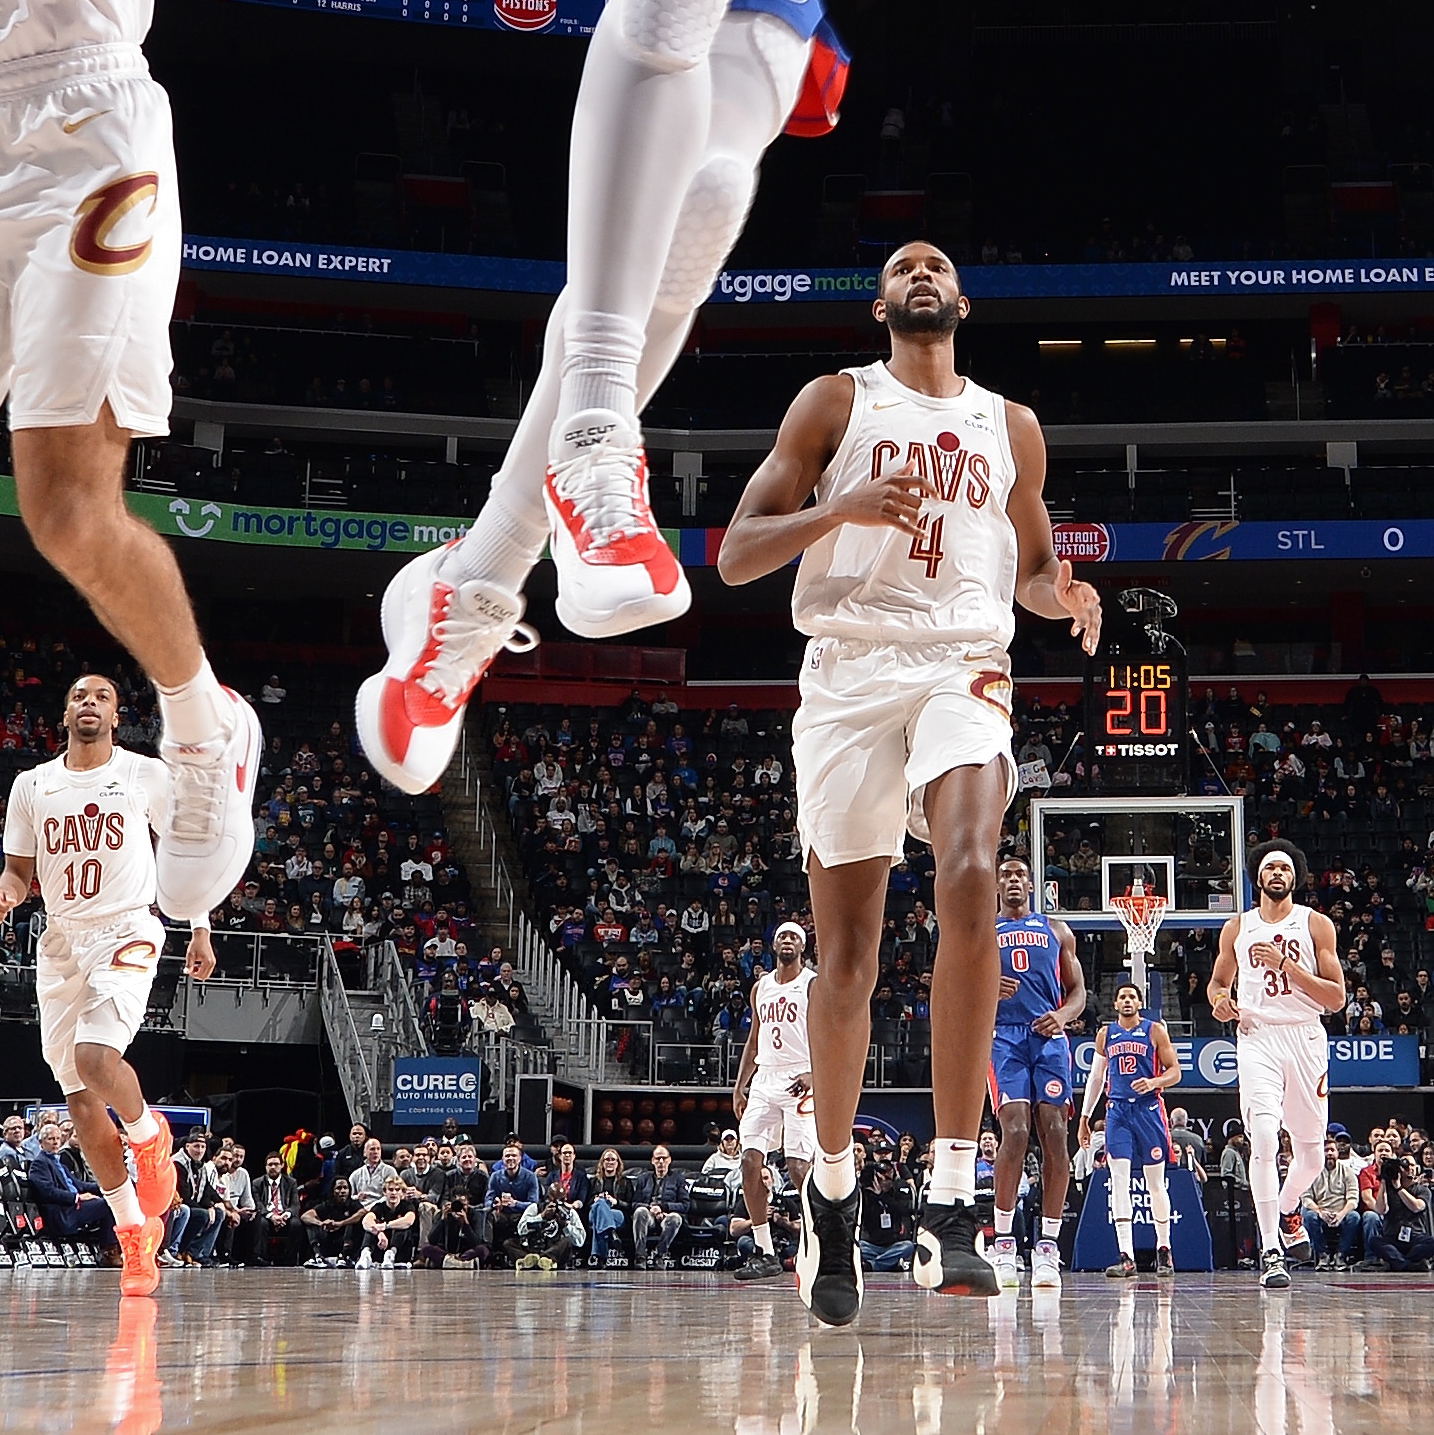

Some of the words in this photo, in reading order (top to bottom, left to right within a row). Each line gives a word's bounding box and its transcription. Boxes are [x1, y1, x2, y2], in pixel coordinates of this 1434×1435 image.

[182, 243, 246, 264] HOME
[252, 247, 312, 269] LOAN
[317, 252, 393, 274] EXPERT
[1170, 270, 1219, 288] MEET
[1222, 268, 1287, 286] YOUR
[1291, 266, 1356, 285] HOME
[1360, 264, 1419, 284] LOAN
[871, 440, 990, 509] CAVS
[908, 512, 945, 579] 4
[1054, 531, 1100, 545] DETROIT
[1054, 542, 1101, 558] PISTONS
[1277, 530, 1325, 550] STL
[1109, 665, 1172, 689] 11:05
[1105, 690, 1168, 736] 20
[1117, 744, 1179, 757] TISSOT
[43, 811, 125, 855] CAVS
[63, 859, 103, 901] 10
[997, 931, 1049, 949] ETROIT
[1012, 948, 1030, 973] 0
[1263, 970, 1293, 997] 31
[759, 1000, 798, 1024] CAVS
[771, 1026, 784, 1050] 3
[1118, 1056, 1137, 1075] 12
[396, 1073, 457, 1091] CURE
[396, 1092, 421, 1100] AUTO
[423, 1092, 476, 1100] INSURANCE
